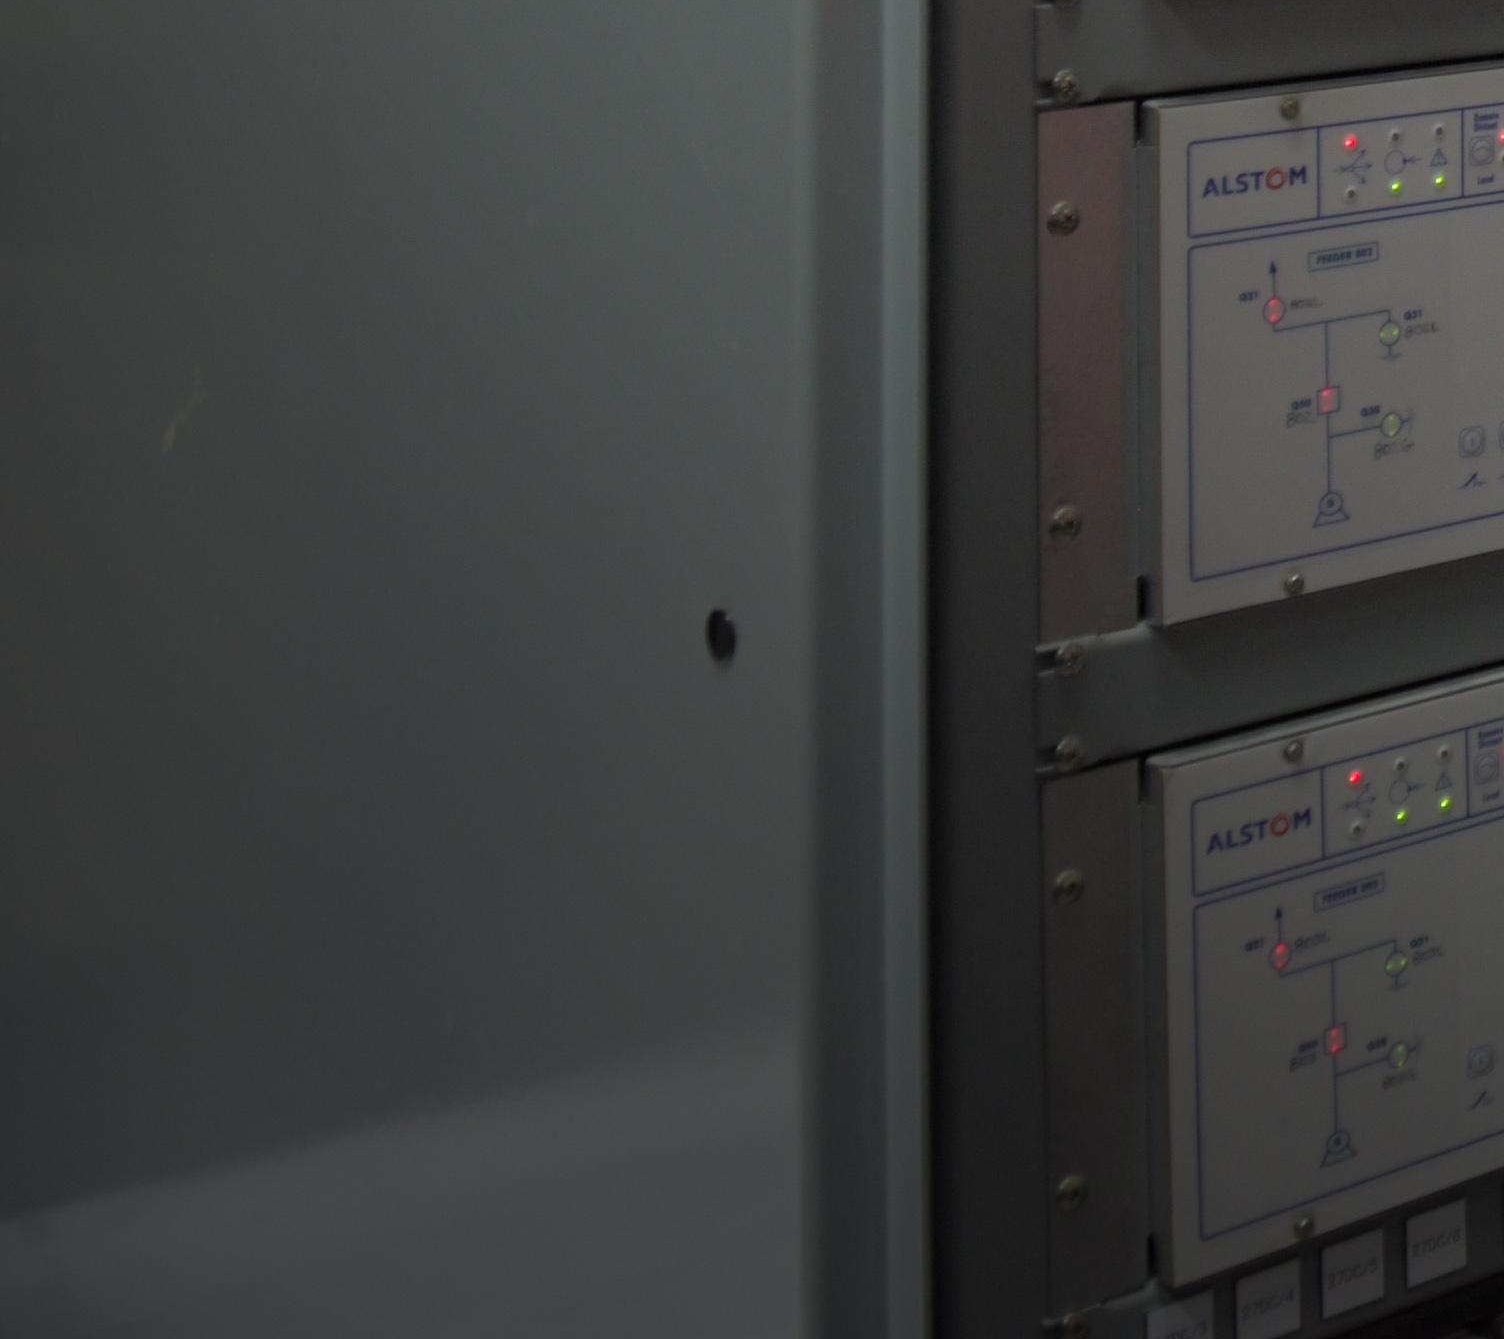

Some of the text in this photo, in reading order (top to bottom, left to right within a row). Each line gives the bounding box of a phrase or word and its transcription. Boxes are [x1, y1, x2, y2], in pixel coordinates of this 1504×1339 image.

[1200, 163, 1310, 200] ALSTOM
[1315, 249, 1353, 265] FEEDER
[1205, 806, 1314, 857] ALSTOM
[1326, 1258, 1380, 1290] 27DC/5
